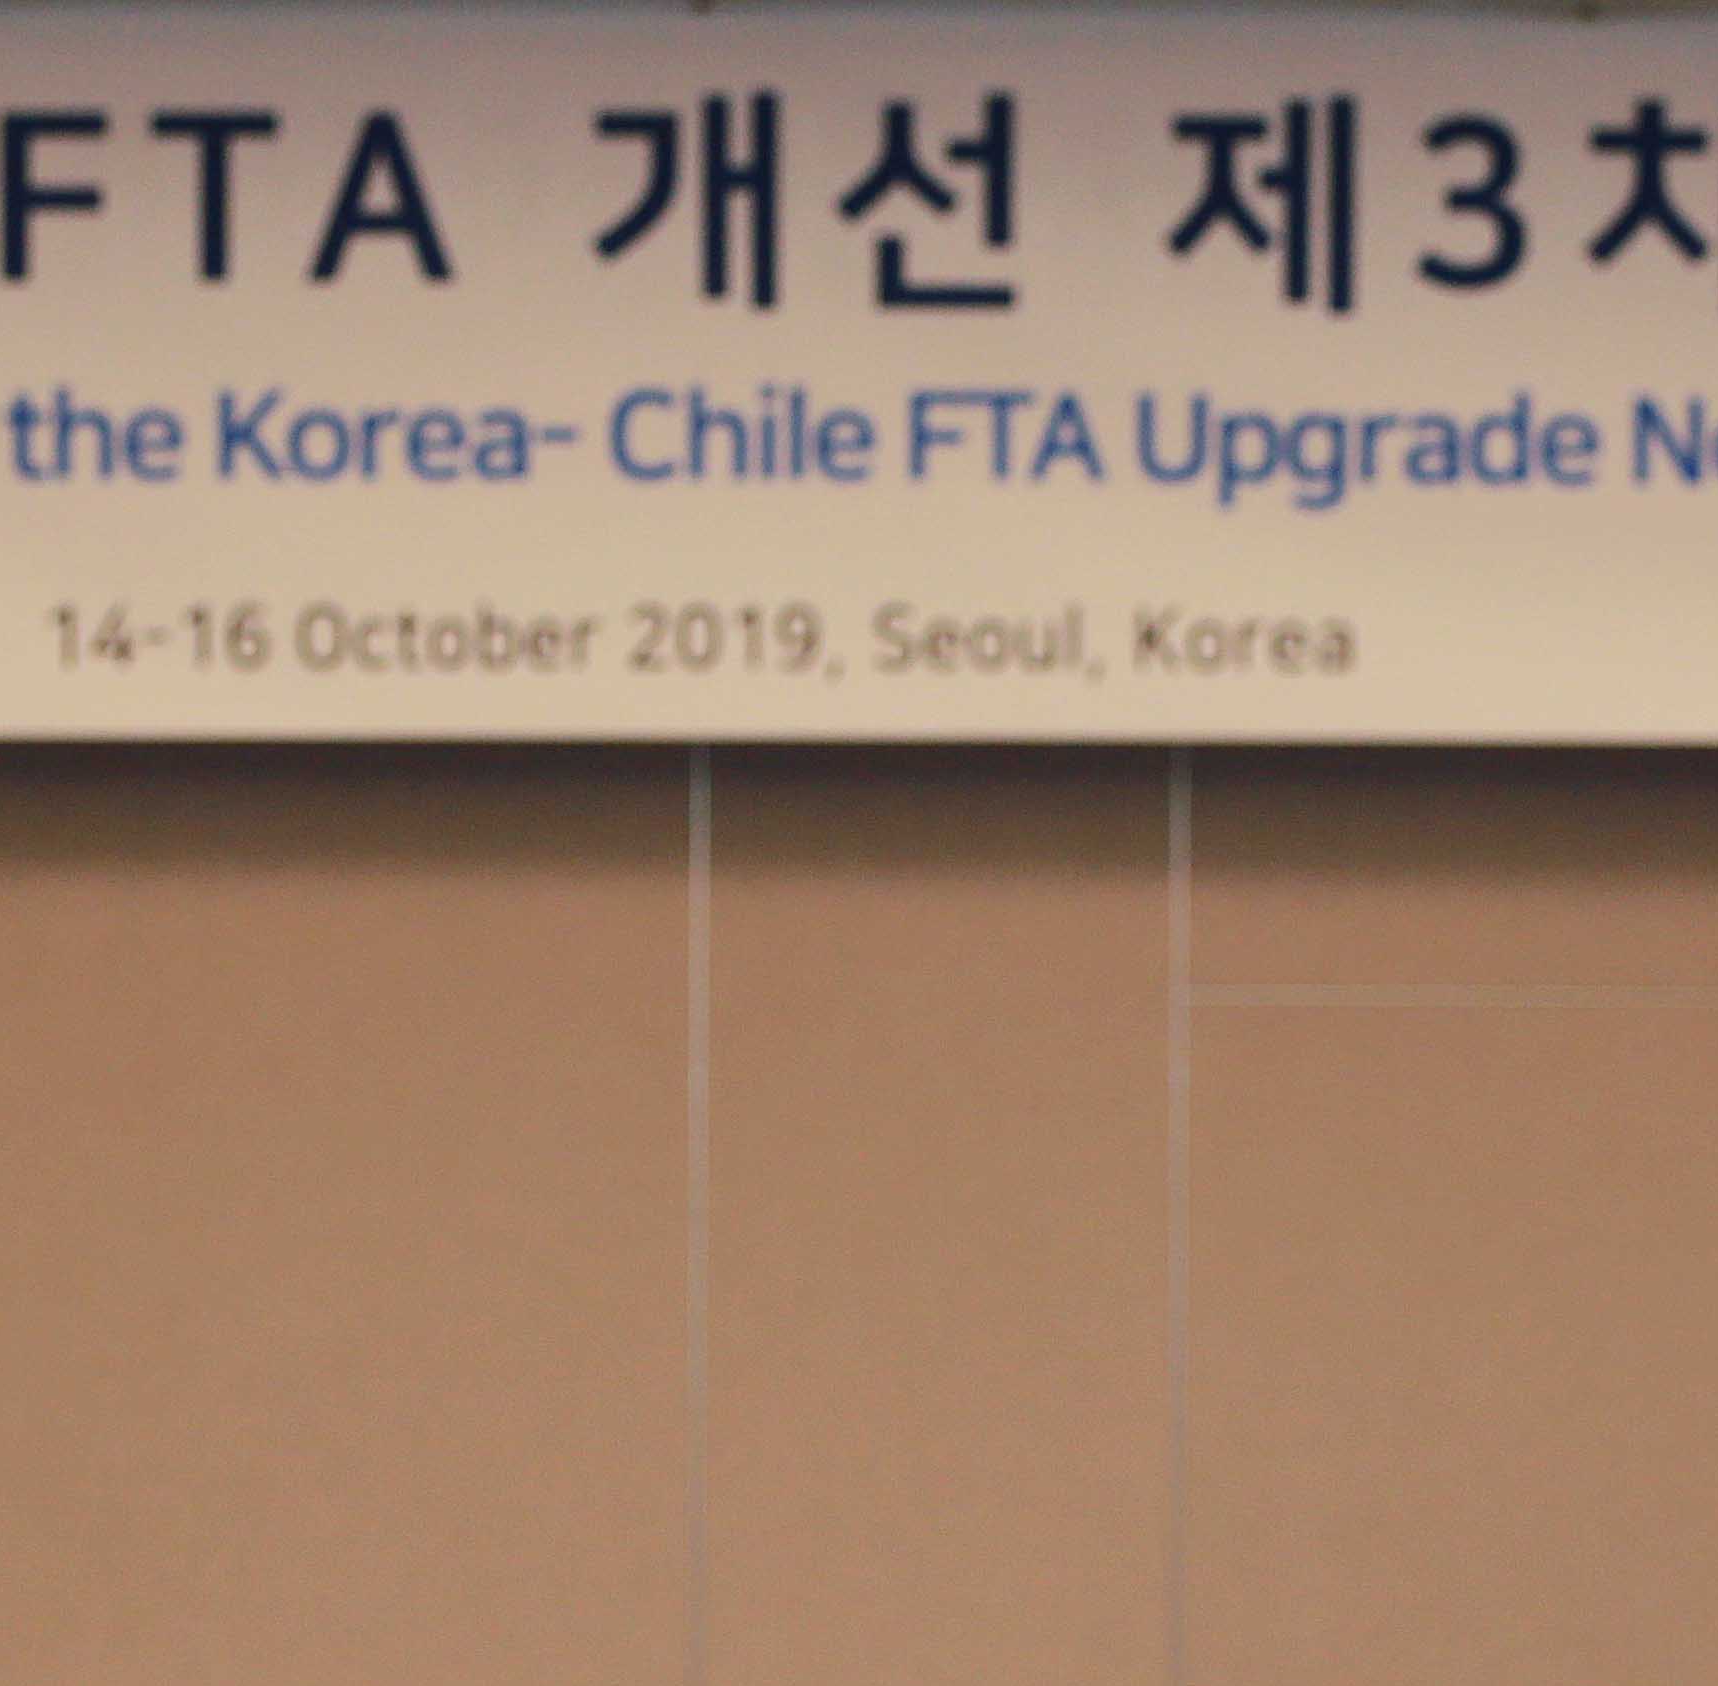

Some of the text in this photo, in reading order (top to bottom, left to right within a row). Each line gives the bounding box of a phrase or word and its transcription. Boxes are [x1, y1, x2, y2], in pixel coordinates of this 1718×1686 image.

[0, 110, 453, 283] FTA
[595, 90, 1015, 311] 개선
[6, 389, 183, 480] the
[609, 386, 875, 482] Chile
[909, 390, 1104, 480] FTA
[1137, 392, 1599, 510] Upgrade
[52, 600, 1355, 678] 14-16 October 2019, Seoul, Korea
